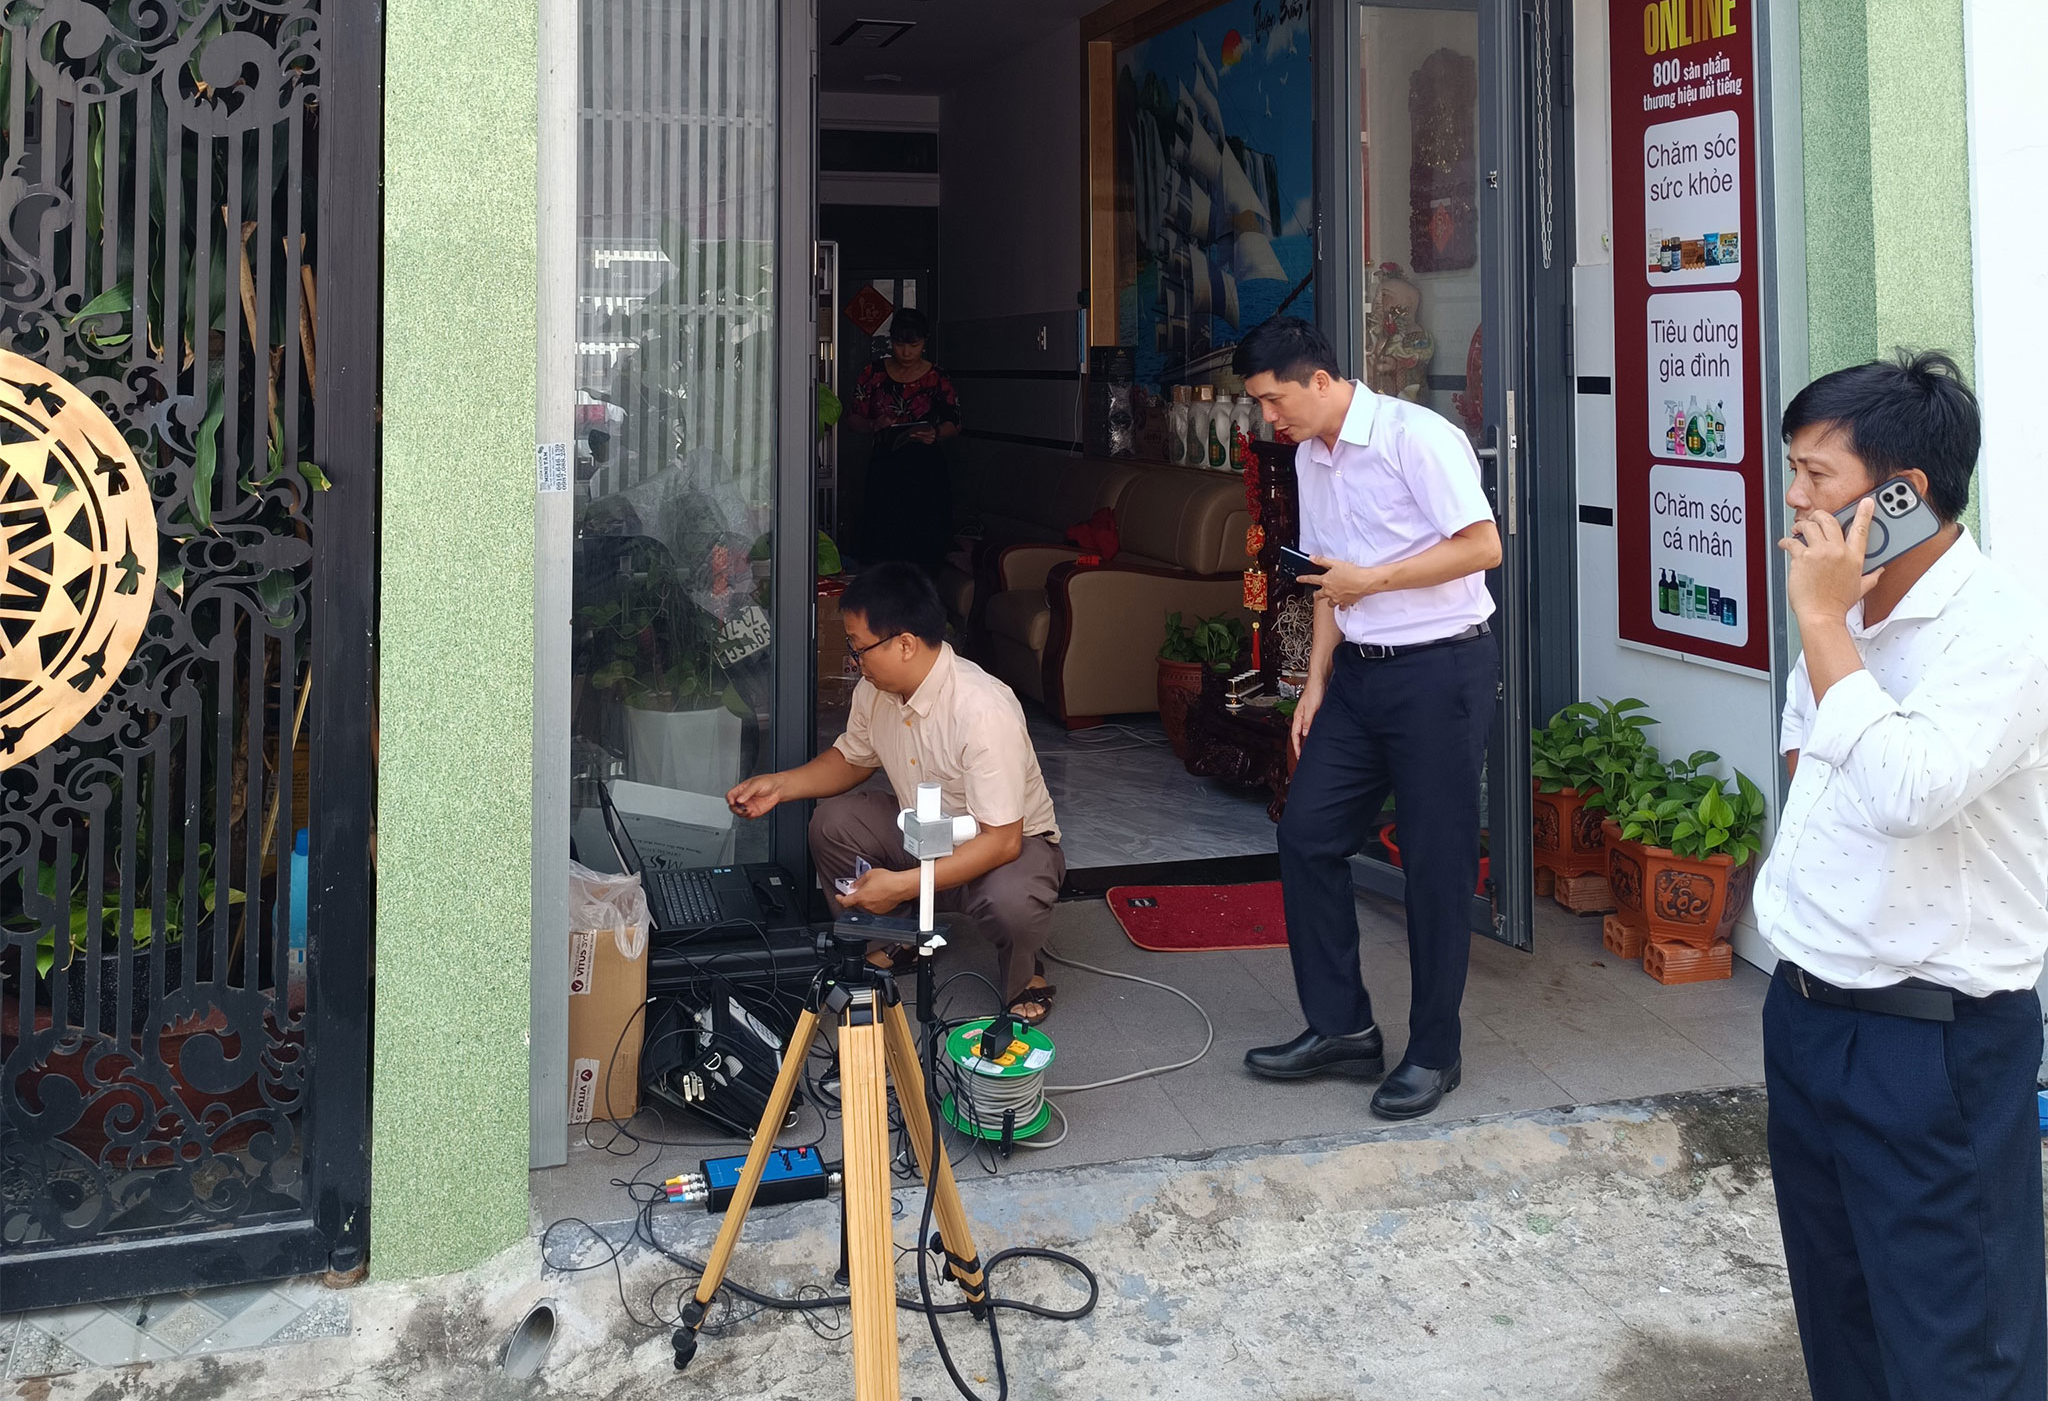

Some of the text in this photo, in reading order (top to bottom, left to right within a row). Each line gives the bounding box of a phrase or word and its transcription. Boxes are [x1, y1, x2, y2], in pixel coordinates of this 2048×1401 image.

[1643, 0, 1737, 56] ONLINE
[1653, 51, 1730, 88] 800 sản phẩm
[1643, 72, 1742, 112] thương hiệu nổi tiếng
[1646, 133, 1737, 168] Chăm sóc
[1650, 168, 1733, 201] sức khỏe
[1650, 318, 1738, 349] Tiêu dùng
[1659, 352, 1730, 383] gia đình
[1654, 491, 1742, 524] Chăm sóc
[1663, 526, 1733, 558] cá nhân
[576, 949, 586, 977] VITUS
[576, 1085, 587, 1112] VITUS
